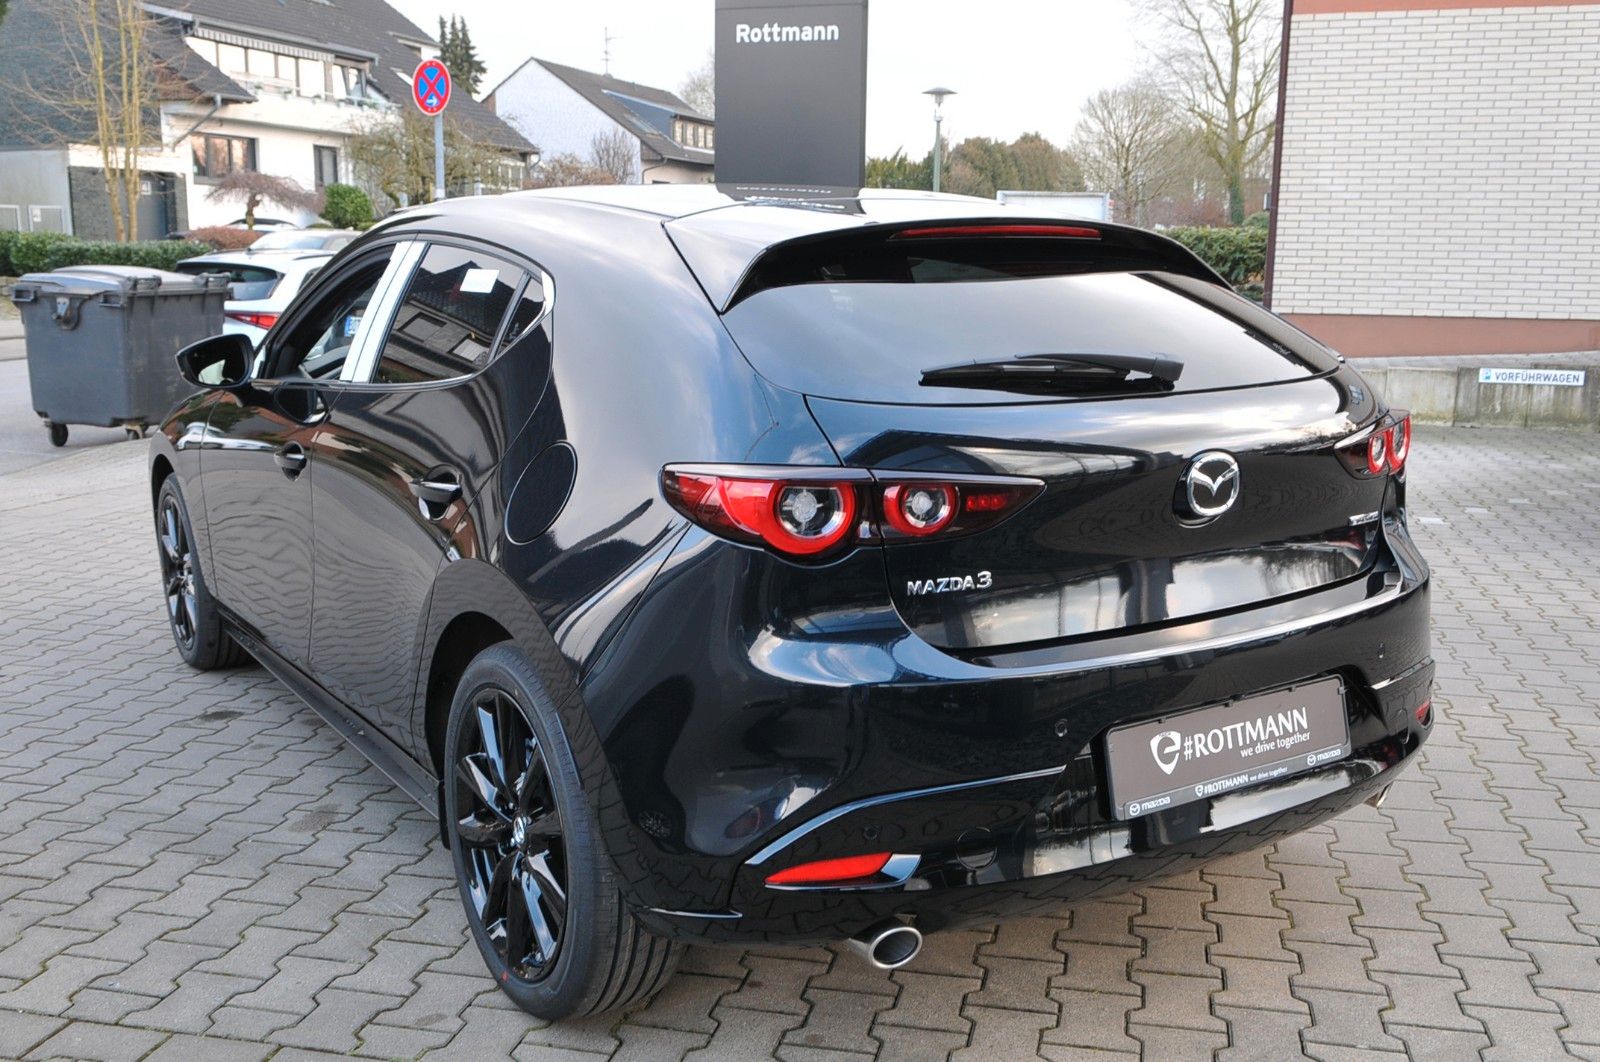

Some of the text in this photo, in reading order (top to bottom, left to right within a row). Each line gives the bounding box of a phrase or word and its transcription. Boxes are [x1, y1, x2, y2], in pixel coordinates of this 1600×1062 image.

[736, 22, 839, 43] Rottmann
[1495, 371, 1580, 383] VORFÜHRWAGEN
[1184, 707, 1308, 760] #ROTTMANN
[1240, 731, 1311, 758] we drive together
[1317, 748, 1342, 761] mazda
[1269, 766, 1289, 777] together
[1141, 796, 1171, 811] mazda
